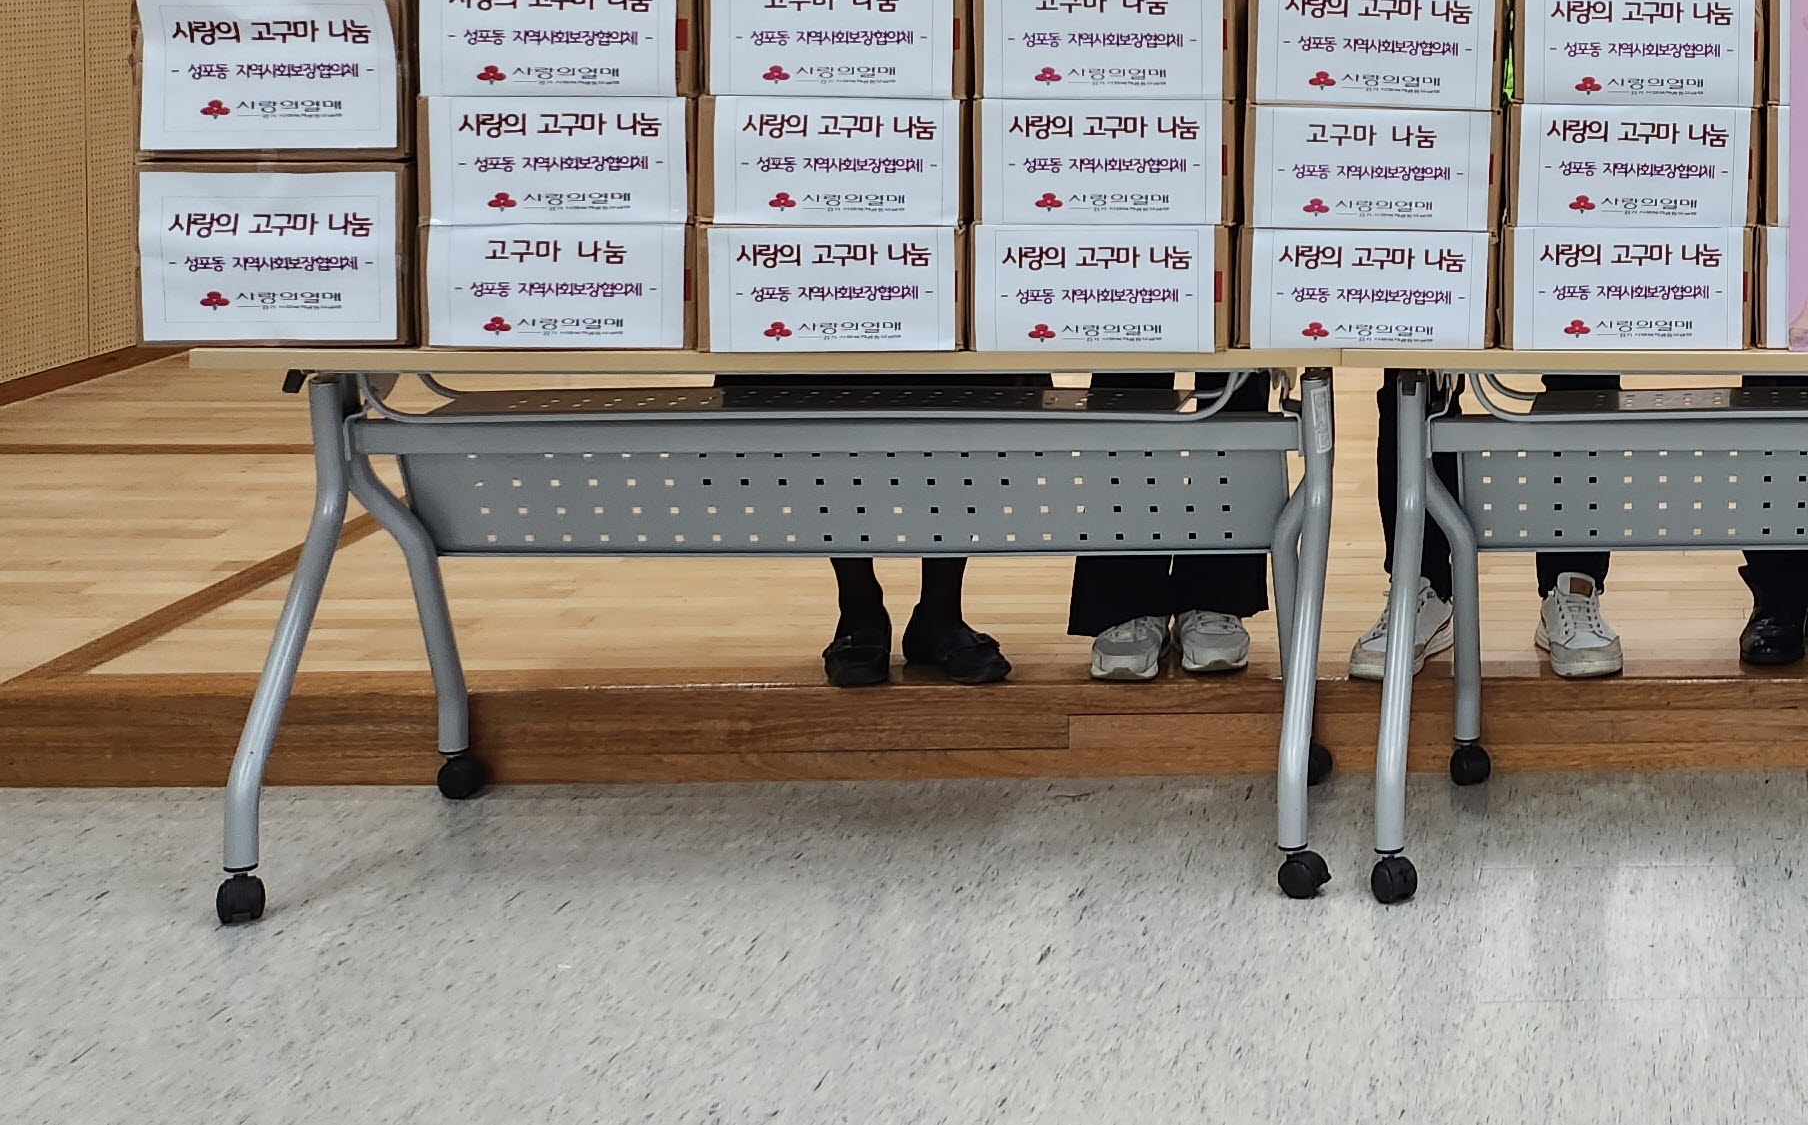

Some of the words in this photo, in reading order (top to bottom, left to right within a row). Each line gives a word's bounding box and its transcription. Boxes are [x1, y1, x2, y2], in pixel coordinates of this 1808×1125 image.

[1430, 0, 1474, 25] 나눔
[1550, 0, 1613, 25] 사랑의
[1621, 1, 1685, 25] 고구마
[1692, 1, 1734, 26] 나눔
[171, 19, 241, 46] 사랑의
[249, 19, 320, 44] 고구마
[327, 18, 373, 45] 나눔
[463, 28, 507, 46] 성포동
[512, 29, 639, 47] 지역사회보장협의체
[1297, 35, 1338, 53] 성포동
[1342, 37, 1459, 57] 지역사회보장협의체
[513, 67, 619, 79] 사랑의열매
[1341, 74, 1440, 88] 사랑의열매
[457, 112, 527, 139] 사랑의
[536, 112, 608, 137] 고구마
[616, 112, 663, 138] 나눔
[741, 113, 809, 140] 사랑의
[817, 114, 885, 139] 고구마
[893, 115, 938, 141] 나눔
[1008, 114, 1074, 141] 사랑의
[1082, 115, 1149, 140] 고구마
[1156, 115, 1201, 141] 나눔
[1305, 123, 1378, 147] 고구마
[1391, 124, 1438, 149] 나눔
[1546, 119, 1609, 144] 사랑의
[1617, 121, 1681, 145] 고구마
[1688, 123, 1730, 148] 나눔
[756, 156, 798, 173] 성포동
[802, 156, 924, 174] 지역사회보장협의체
[803, 194, 905, 206] 사랑의열매
[167, 212, 240, 239] 사랑의
[248, 212, 320, 237] 고구마
[328, 211, 374, 238] 나눔
[484, 239, 562, 264] 고구마
[577, 239, 628, 265] 나눔
[736, 243, 802, 269] 사랑의
[811, 243, 879, 268] 고구마
[887, 242, 933, 267] 나눔
[1001, 245, 1066, 272] 사랑의
[1075, 245, 1141, 270] 고구마
[1149, 245, 1193, 271] 나눔
[1278, 244, 1343, 270] 사랑의
[1351, 246, 1416, 271] 고구마
[1424, 248, 1467, 273] 나눔
[1539, 243, 1602, 269] 사랑의
[1610, 243, 1674, 267] 고구마
[1681, 243, 1723, 268] 나눔
[1015, 288, 1056, 305] 성포동
[1061, 287, 1179, 305] 지역사회보장협의체
[1552, 284, 1592, 301] 성포동
[1596, 284, 1710, 301] 지역사회보장협의체
[1061, 324, 1161, 338] 사랑의열매
[1596, 320, 1692, 335] 사랑의열매
